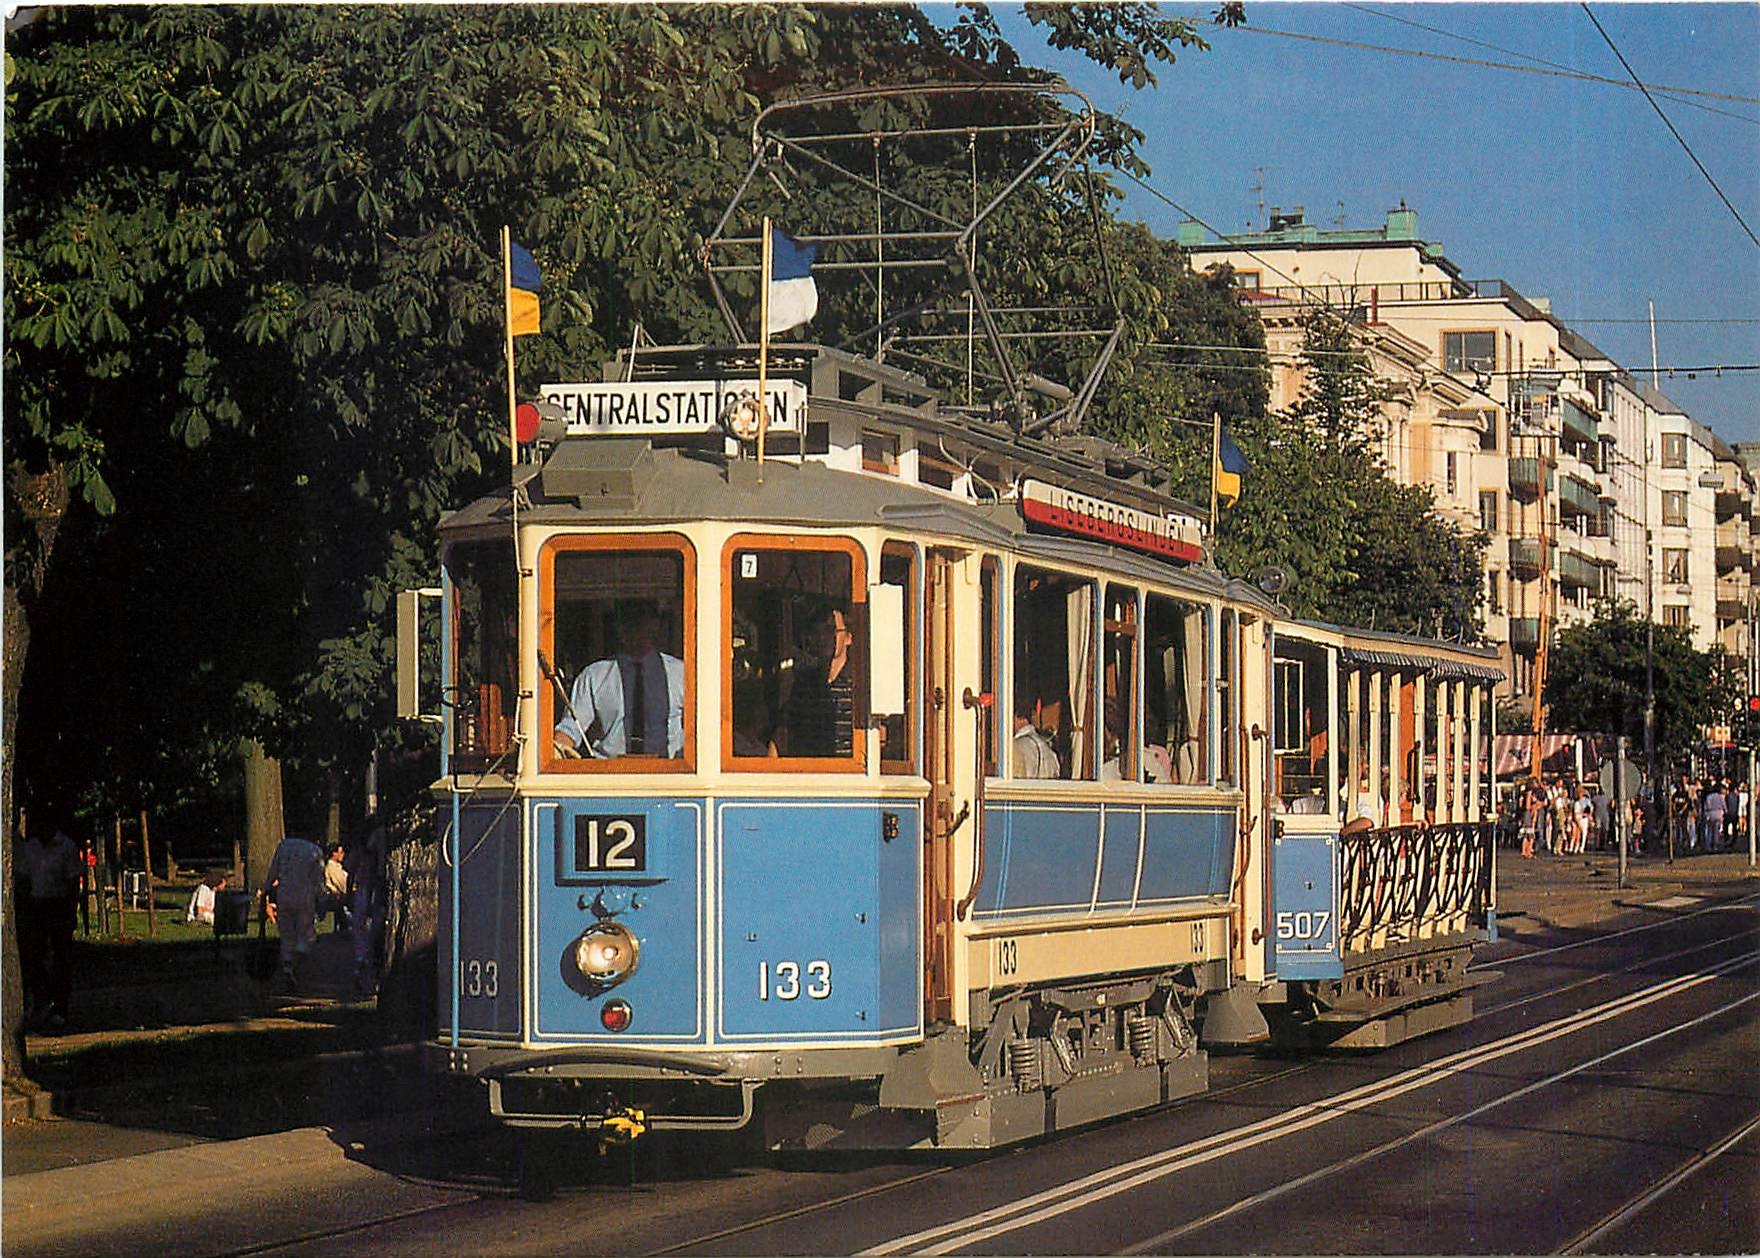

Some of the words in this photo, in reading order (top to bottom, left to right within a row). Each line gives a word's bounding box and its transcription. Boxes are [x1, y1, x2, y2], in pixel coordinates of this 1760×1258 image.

[547, 391, 787, 425] ENTRALSTATIN
[745, 560, 754, 575] 7
[588, 819, 637, 868] 12
[1190, 922, 1205, 954] 133
[1277, 911, 1330, 939] 507
[999, 939, 1017, 975] 133
[460, 959, 498, 998] 133
[759, 960, 832, 1001] 133
